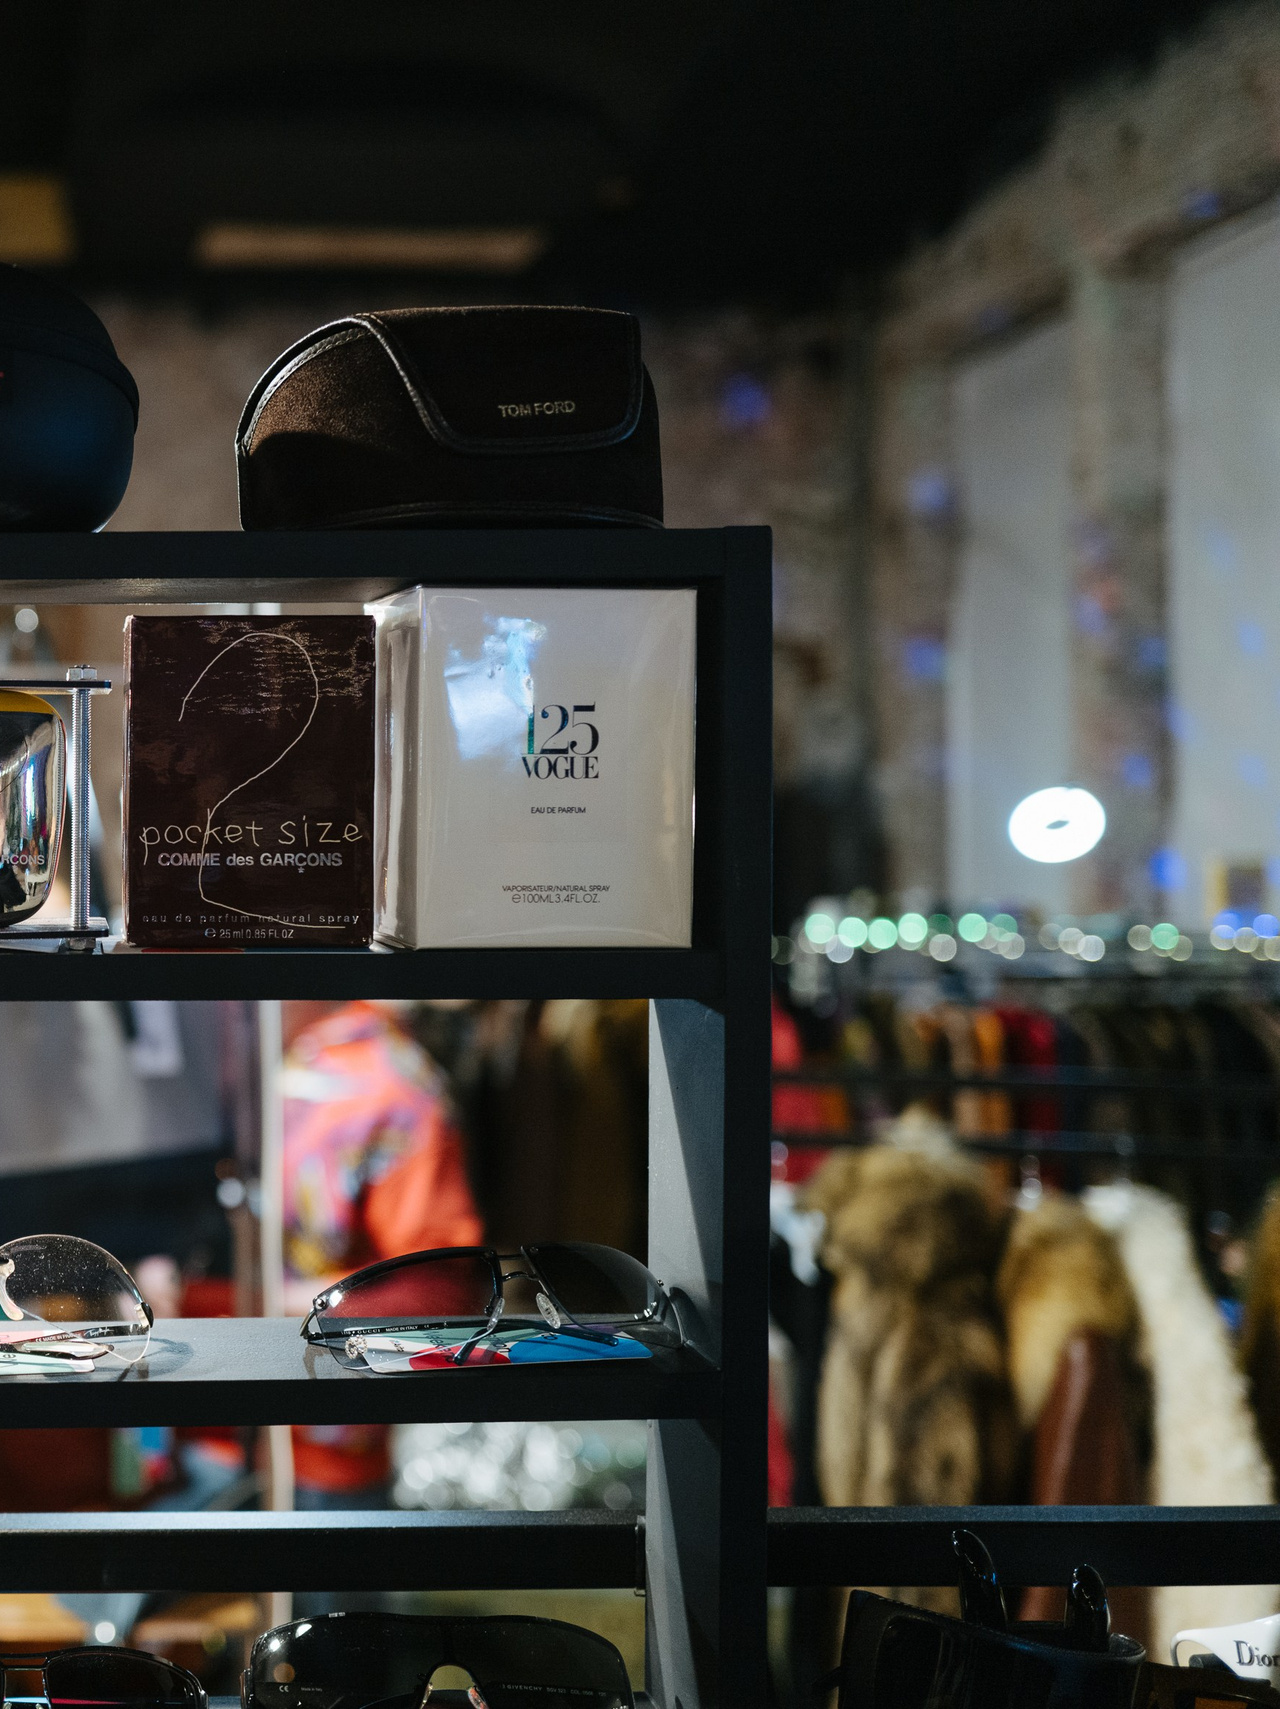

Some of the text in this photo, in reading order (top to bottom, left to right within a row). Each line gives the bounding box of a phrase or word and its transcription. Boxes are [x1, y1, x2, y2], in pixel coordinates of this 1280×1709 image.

[498, 400, 576, 418] TOM FORD
[522, 701, 600, 755] 125
[521, 755, 600, 780] VOGUE
[531, 806, 586, 814] EAU DE PARFUM
[139, 808, 363, 865] pocket size
[158, 852, 343, 873] COMME des GARÇONS
[143, 913, 360, 925] eau de parfum natural spray
[220, 928, 231, 939] 25
[232, 928, 243, 939] ml
[245, 928, 266, 939] 0.85
[507, 1684, 542, 1692] GIVENCHY
